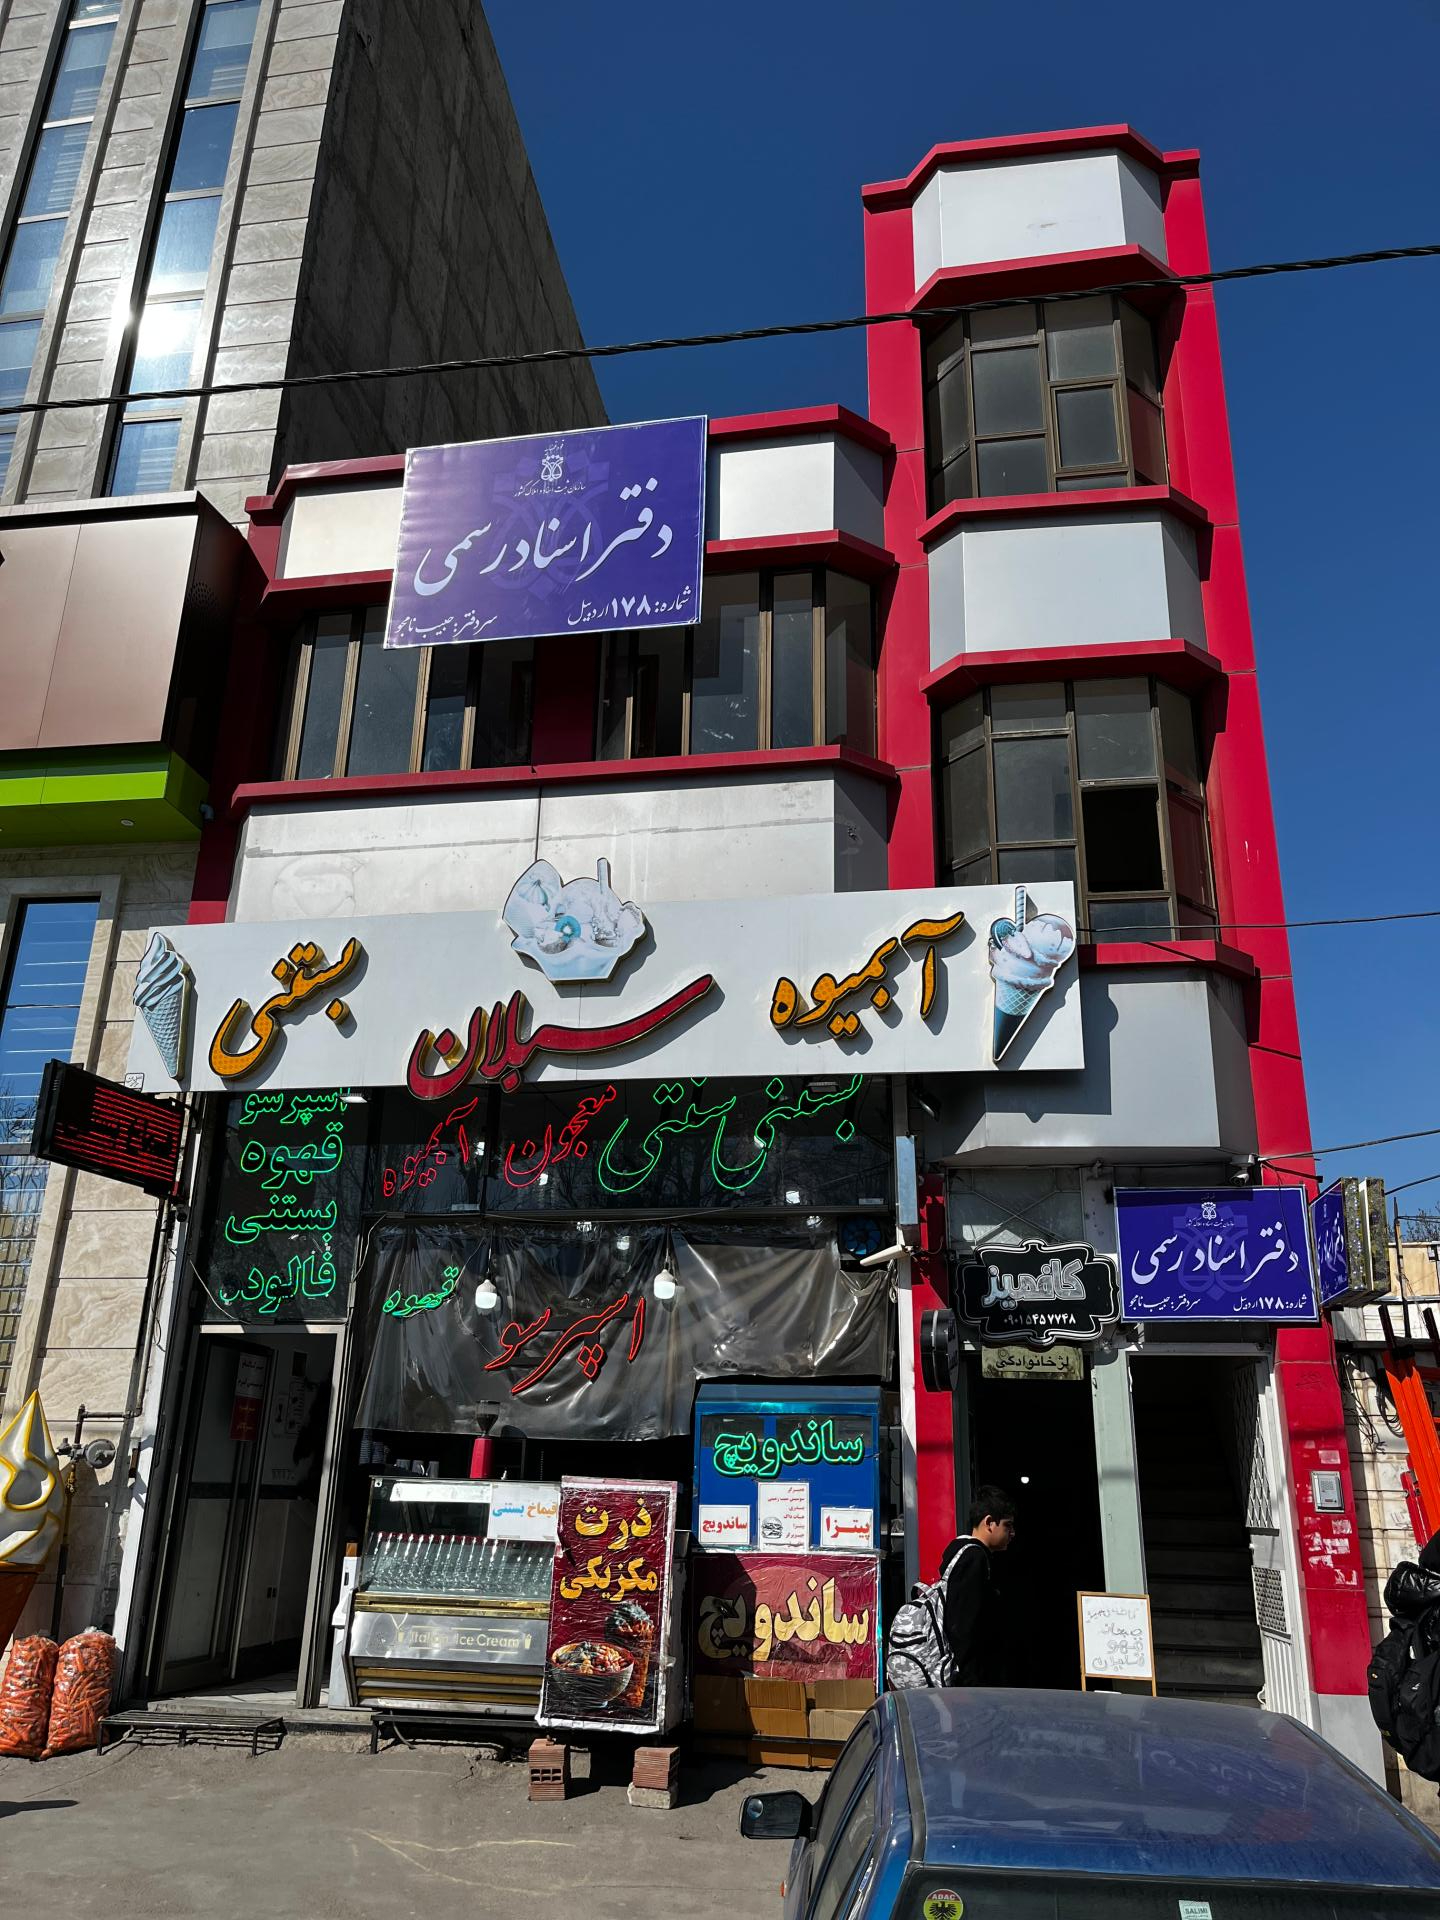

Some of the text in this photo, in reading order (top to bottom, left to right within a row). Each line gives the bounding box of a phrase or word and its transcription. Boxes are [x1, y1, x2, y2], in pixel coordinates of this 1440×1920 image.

[413, 477, 673, 596] دفتر اسناد رسمی
[415, 616, 455, 639] حبیب
[567, 599, 609, 626] اردبیل
[611, 594, 651, 619] ۱۷۸
[209, 910, 965, 1101] آبمیوه سبلان بستنی
[240, 1122, 344, 1189] قهوه
[383, 1097, 478, 1198] آبمیوه
[503, 1084, 617, 1189] معجون
[225, 1194, 338, 1244] بستنی
[1131, 1233, 1184, 1285] رسمی
[1191, 1236, 1246, 1272] اسناد
[1243, 1222, 1299, 1284] دفتر
[382, 1265, 460, 1318] قهوه
[1258, 1296, 1285, 1311] ۱۷۸
[485, 1291, 647, 1395] اسپرسو
[1004, 1313, 1077, 1325] ۰۹۰۱۵۴۵۷۷۴۸
[1056, 1355, 1069, 1371] لژ
[713, 1417, 865, 1478] ساندویچ
[492, 1503, 525, 1517] بستنی
[574, 1498, 653, 1551] ذرت
[825, 1516, 871, 1542] پیتزا
[559, 1555, 658, 1602] مکزیکی
[455, 1632, 474, 1645] Ice
[476, 1633, 520, 1649] Cream
[698, 1576, 870, 1663] ساندویچ
